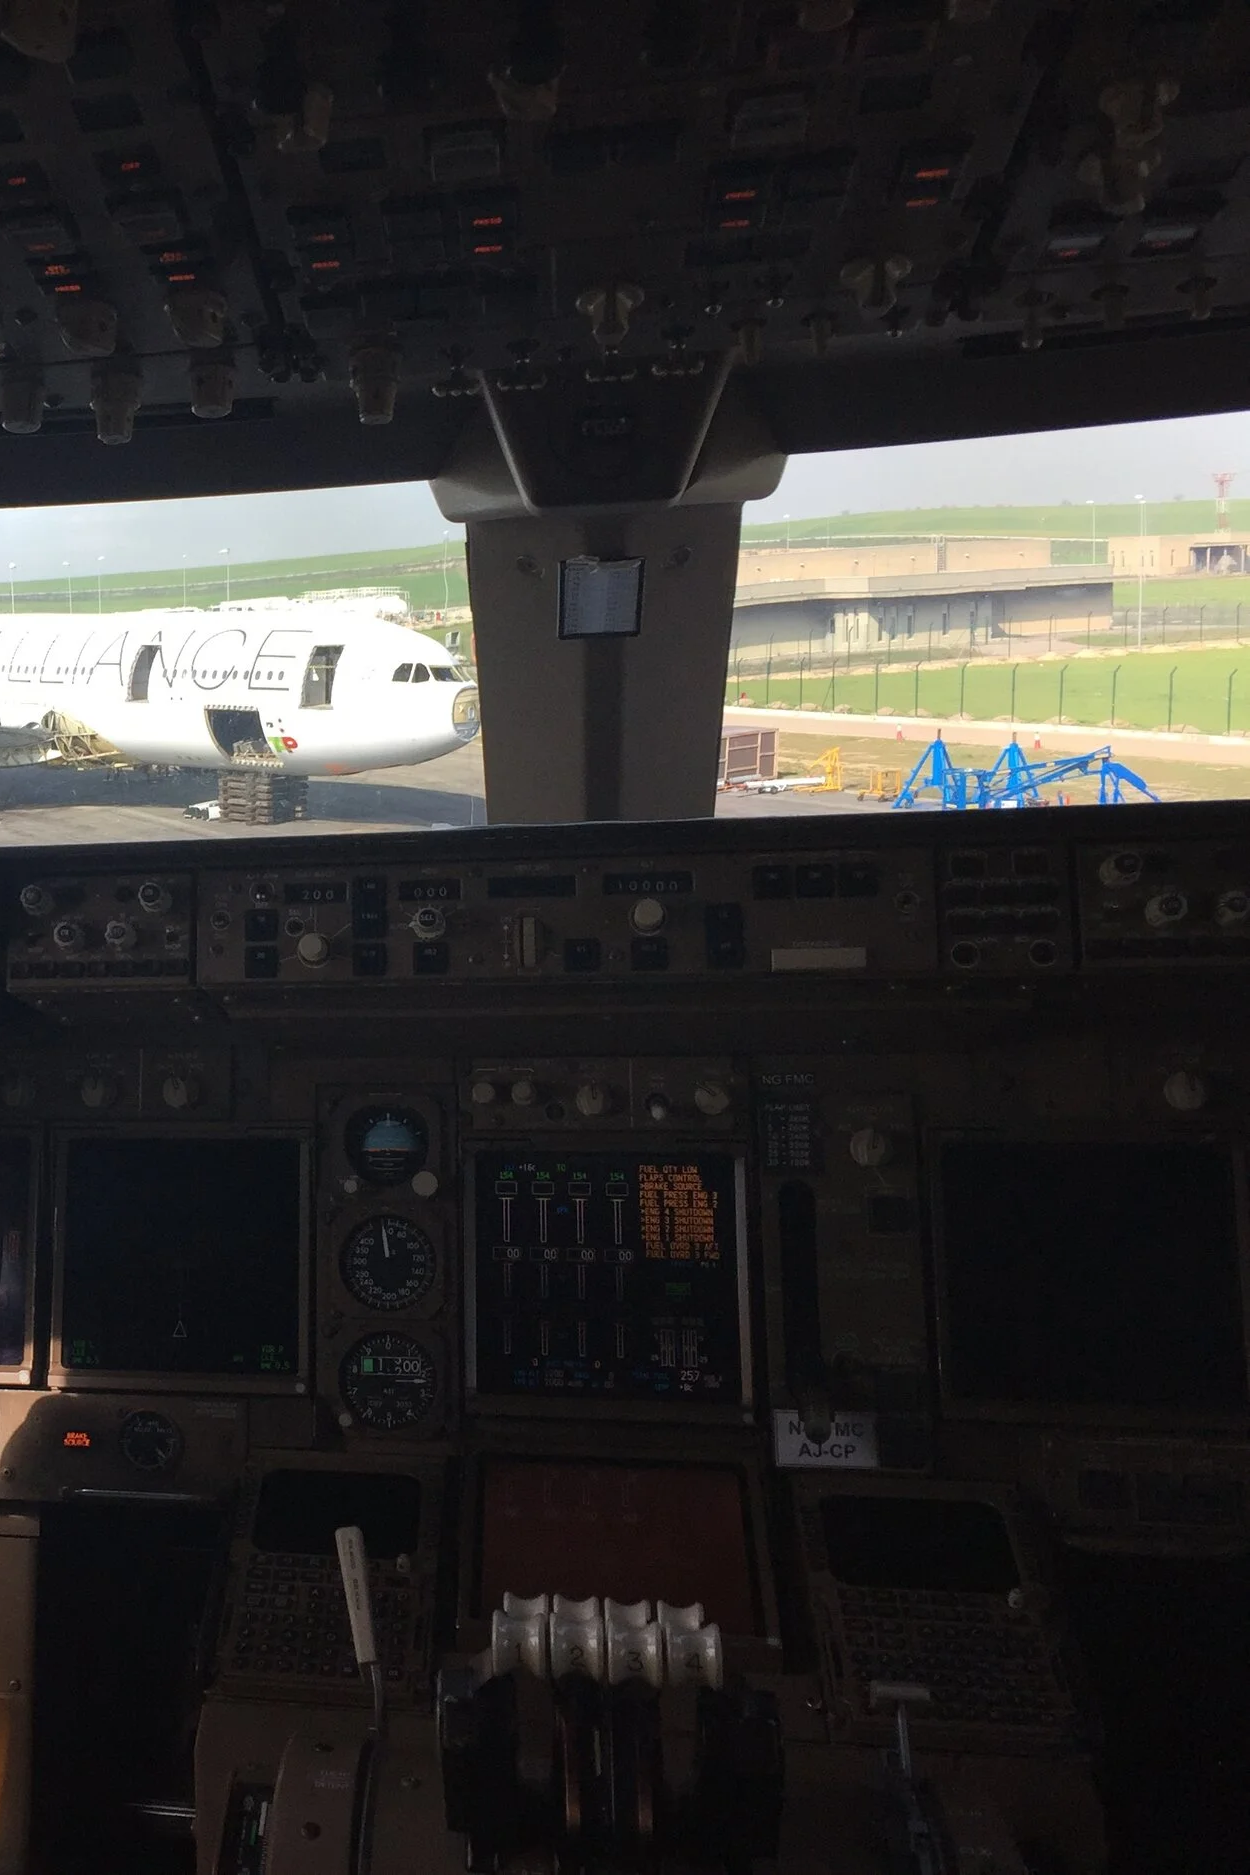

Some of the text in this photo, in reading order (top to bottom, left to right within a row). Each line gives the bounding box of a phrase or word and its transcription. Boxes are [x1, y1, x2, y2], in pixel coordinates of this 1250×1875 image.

[617, 880, 679, 892] 10000
[302, 889, 335, 900] 200
[414, 887, 447, 898] 000
[761, 1074, 815, 1085] NG FMC
[639, 1165, 658, 1173] FUEL
[639, 1174, 701, 1182] FLAPS CONTROL
[673, 1182, 702, 1190] SOURCE
[639, 1191, 659, 1199] FUEL
[664, 1191, 688, 1199] PRESS
[693, 1191, 708, 1199] ENG
[639, 1199, 659, 1207] FUEL
[693, 1200, 708, 1208] ENG
[674, 1208, 714, 1216] SHUTDOWN
[674, 1216, 714, 1224] SHUTDOWN
[674, 1225, 714, 1233] SHUTDOWN
[674, 1234, 714, 1242] SHUTDOWN
[66, 1431, 88, 1439] BRAKE
[63, 1438, 90, 1447] SOURCE
[798, 1442, 856, 1459] AJ-CP
[515, 1642, 524, 1662] 1
[570, 1644, 586, 1668] 2
[627, 1651, 644, 1673] 3
[685, 1652, 703, 1673] 4
